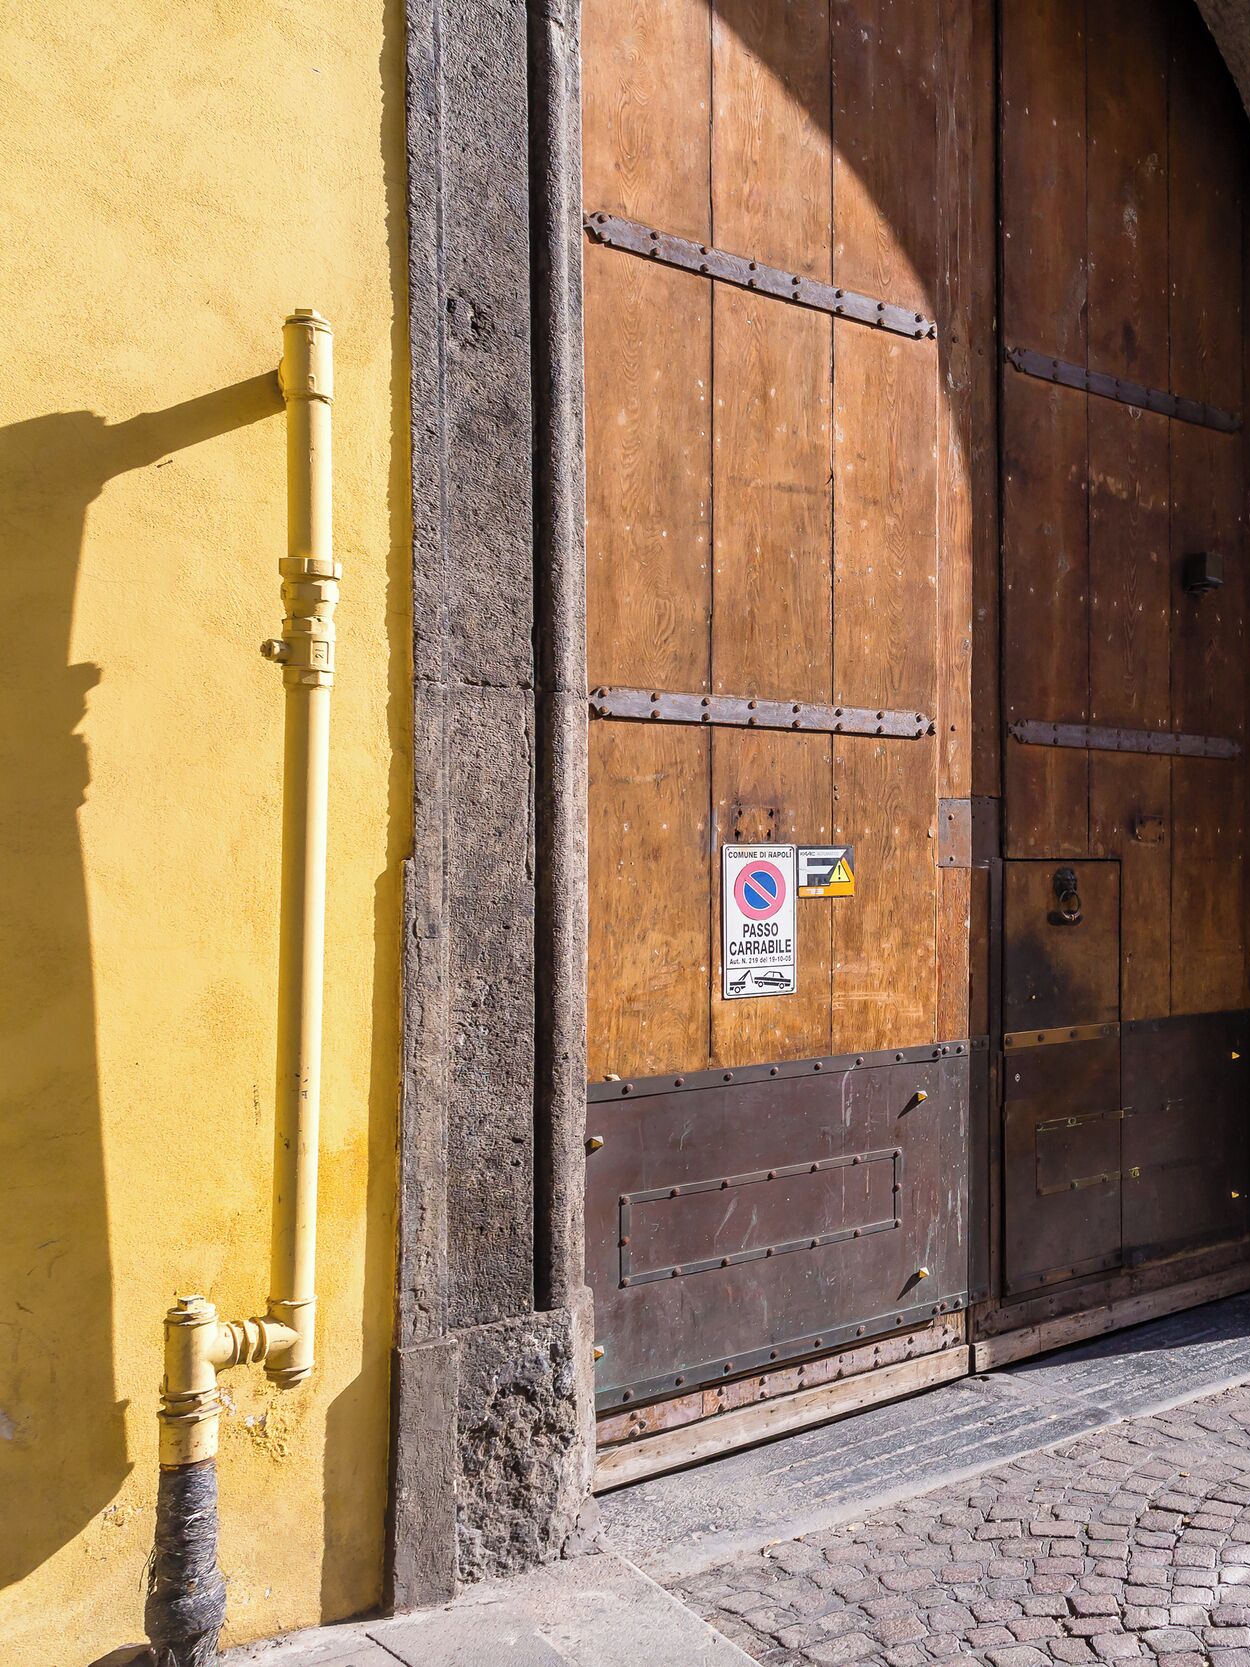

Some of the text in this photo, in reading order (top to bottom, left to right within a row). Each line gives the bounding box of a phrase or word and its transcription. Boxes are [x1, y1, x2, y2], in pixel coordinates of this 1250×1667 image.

[728, 851, 792, 859] COMUNE DI NAPOLI
[743, 922, 779, 938] PASSO
[729, 939, 792, 956] CARRABILE
